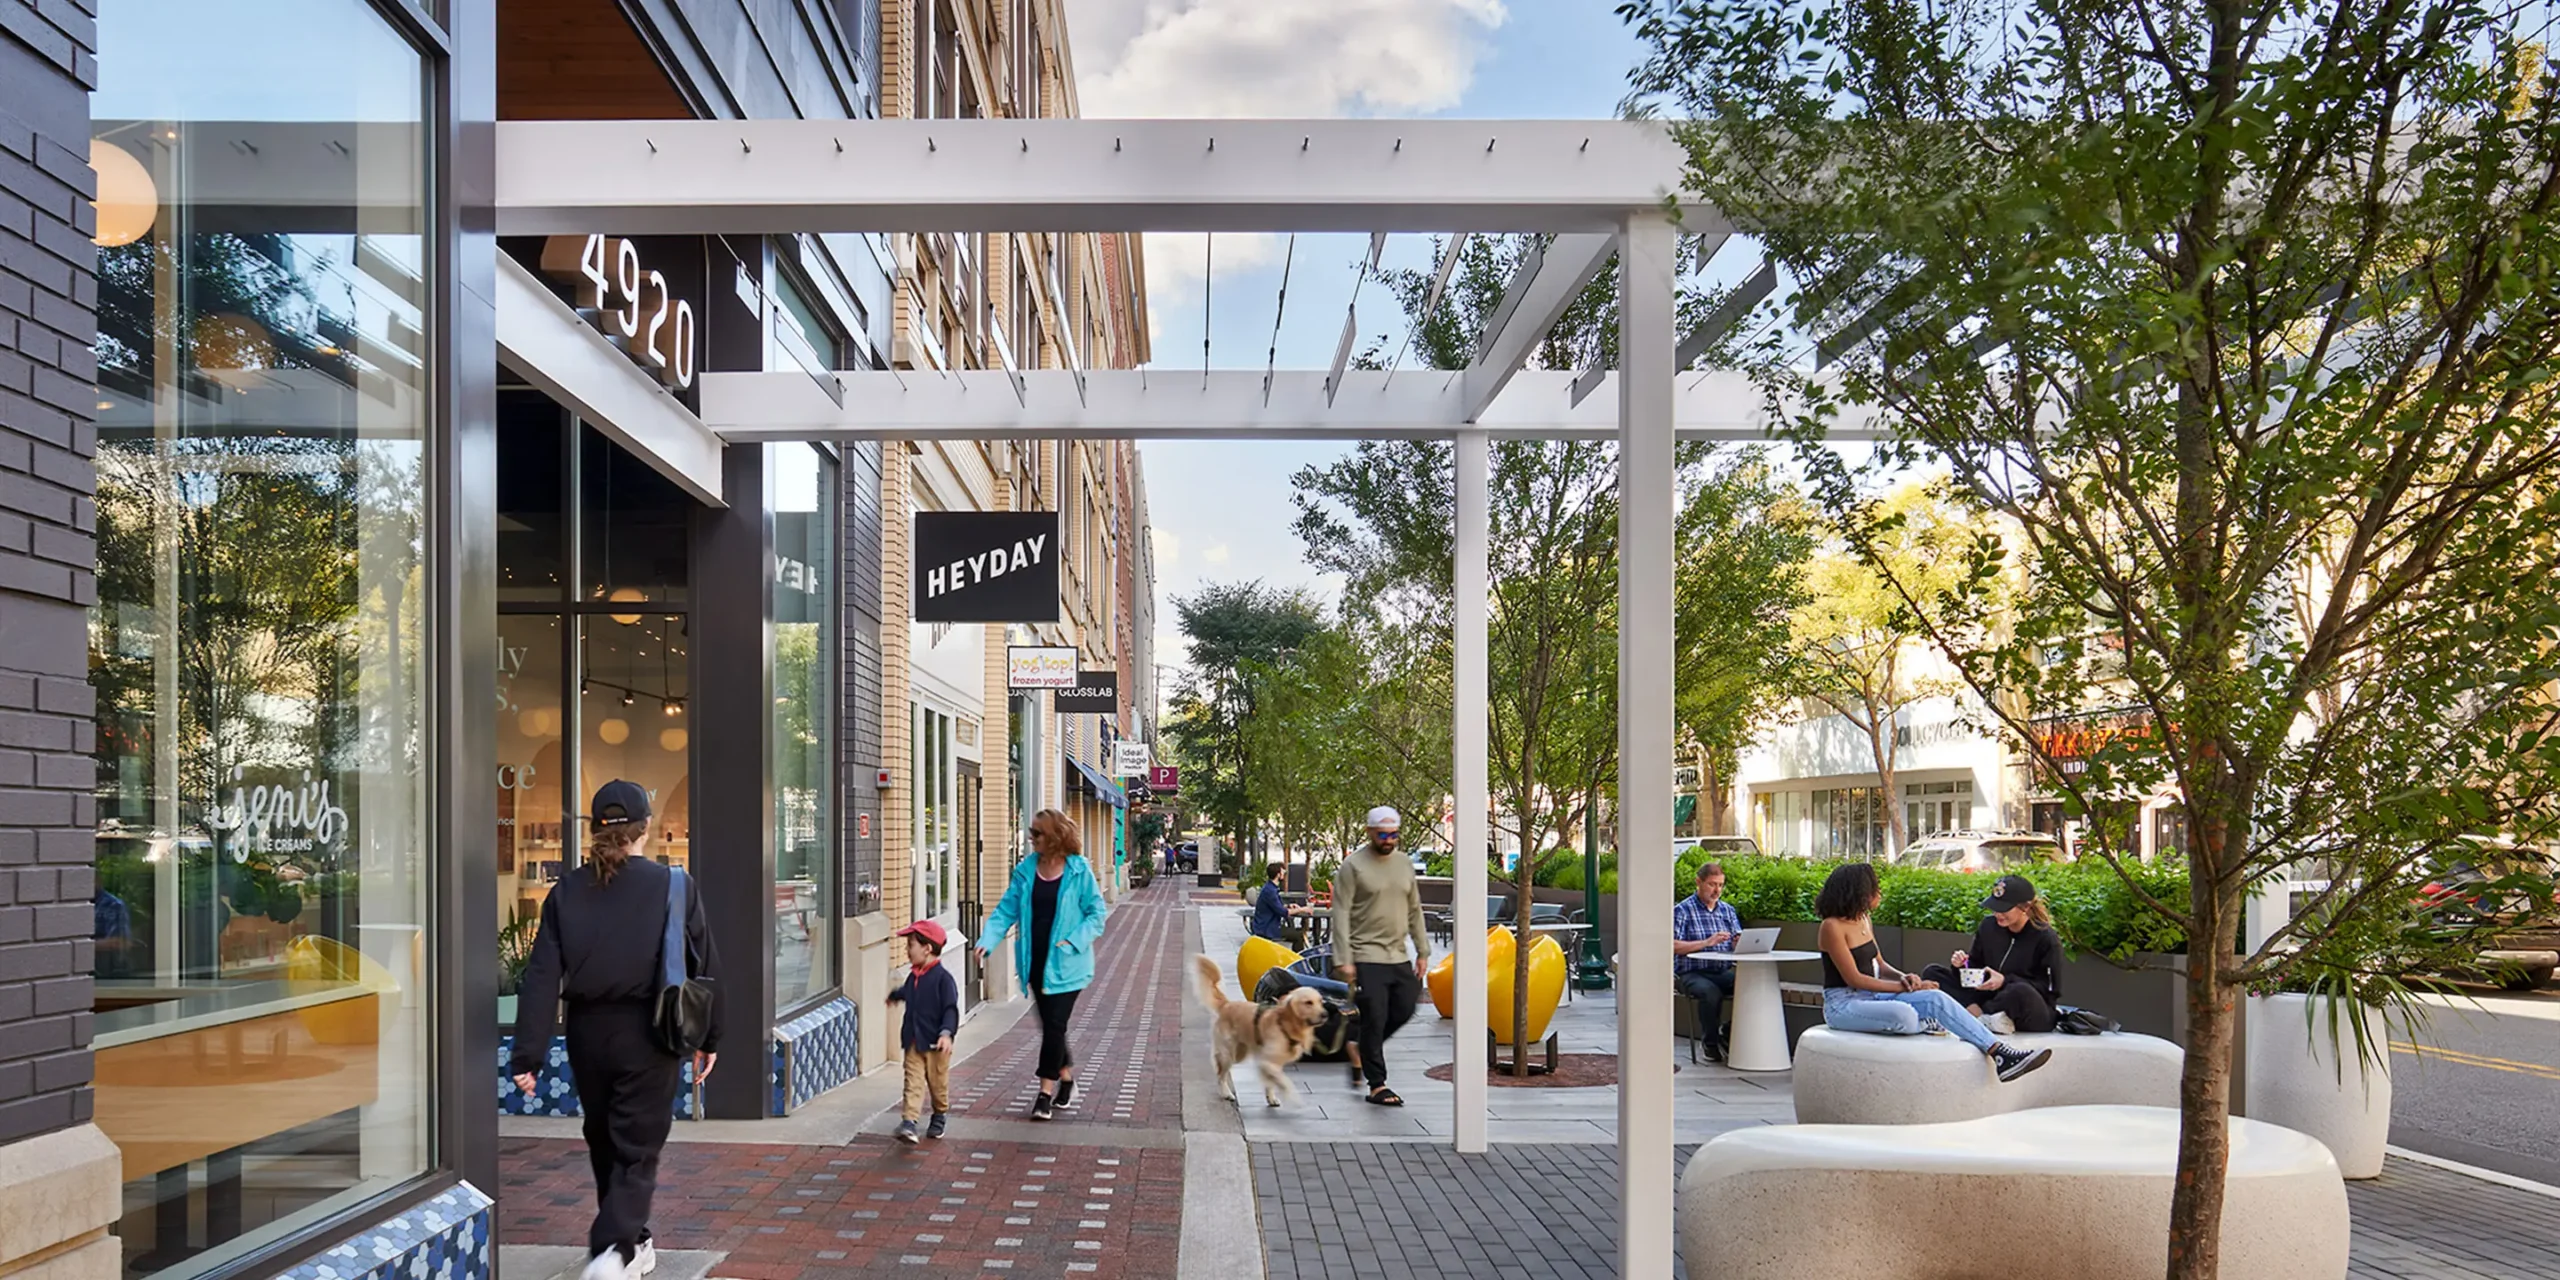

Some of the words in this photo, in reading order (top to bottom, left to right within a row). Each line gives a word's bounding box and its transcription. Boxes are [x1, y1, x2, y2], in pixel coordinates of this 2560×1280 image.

[581, 234, 694, 388] 4920
[928, 533, 1047, 598] HEYDAY
[1012, 676, 1041, 685] frozen
[1043, 677, 1073, 686] yogurt
[1059, 687, 1113, 697] GLOSSLAB
[1122, 748, 1143, 756] Ideal
[1120, 756, 1147, 765] Image
[1160, 769, 1170, 783] P
[211, 765, 348, 864] jeni's
[275, 838, 313, 851] CREAMS
